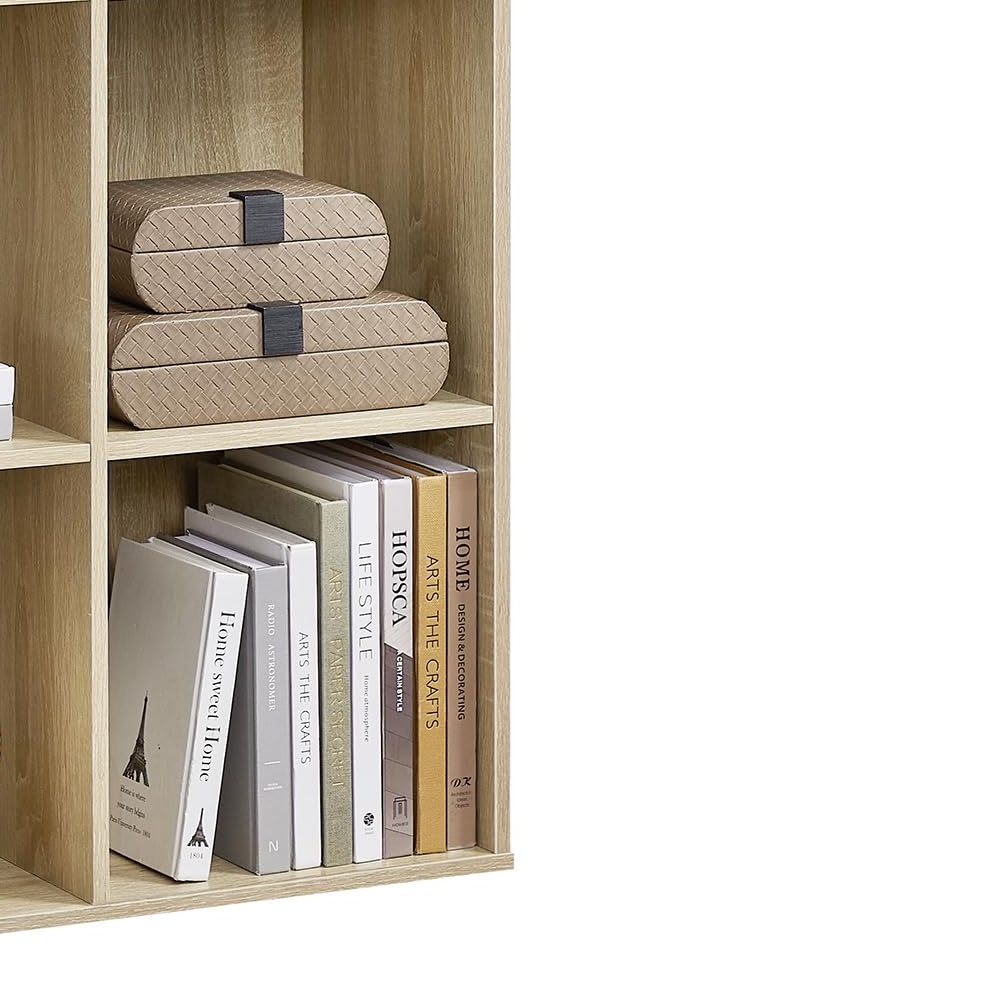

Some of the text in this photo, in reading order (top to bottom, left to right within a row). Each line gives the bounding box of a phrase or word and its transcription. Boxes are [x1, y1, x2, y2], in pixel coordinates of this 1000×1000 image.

[358, 542, 373, 661] LIFE STYLE
[392, 530, 408, 626] HOPSCA
[425, 555, 440, 729] ARTS THE CRAFTS
[455, 526, 471, 721] HOME DESIGN & DECORATING
[200, 611, 235, 782] Home sweet Home
[267, 603, 277, 713] RADIO ASTRONOMER
[298, 631, 312, 764] ARTS THE CRAFTS
